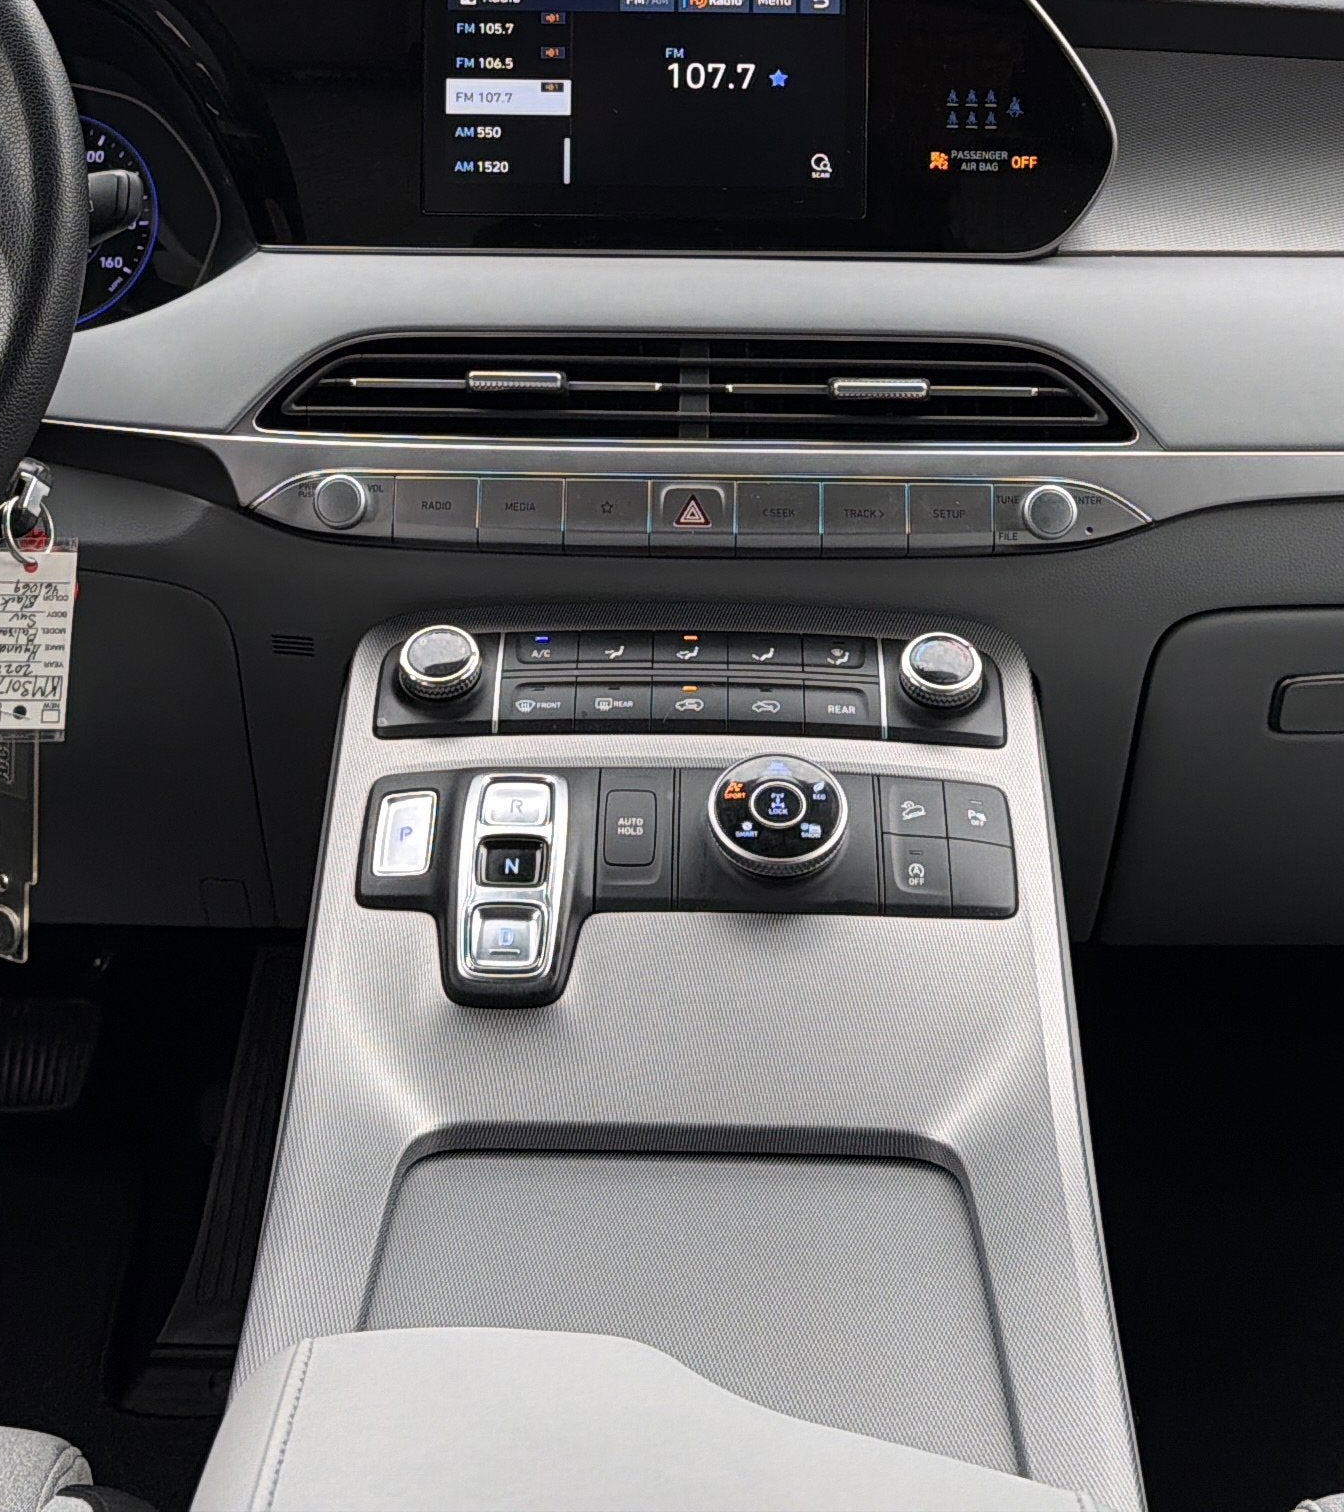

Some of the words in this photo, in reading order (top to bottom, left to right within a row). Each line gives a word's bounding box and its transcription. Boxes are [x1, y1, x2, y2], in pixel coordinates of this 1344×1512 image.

[456, 22, 475, 35] FM
[478, 22, 514, 35] 105.7
[665, 48, 684, 59] FM
[456, 57, 475, 69] FM
[478, 57, 514, 70] 106.5
[666, 63, 756, 90] 107.7
[455, 92, 474, 104] FM
[478, 92, 513, 104] 107.7
[454, 126, 474, 138] AM
[476, 126, 502, 139] 550
[951, 150, 1008, 160] PASSENGER
[1011, 156, 1038, 169] OFF
[454, 161, 474, 173] AM
[476, 161, 509, 174] 1520
[960, 162, 977, 171] AIR
[978, 162, 999, 172] BAG
[99, 256, 123, 268] 160
[421, 500, 452, 511] RADIO
[996, 496, 1020, 505] TUNE
[504, 502, 536, 513] MEDIA
[932, 508, 967, 519] SETUP
[999, 532, 1018, 541] FILE
[531, 648, 551, 658] A/C
[42, 701, 61, 709] NEW
[537, 701, 562, 709] FRONT
[610, 700, 634, 709] REAR
[827, 704, 856, 715] REAR
[509, 798, 524, 815] R
[618, 815, 644, 825] AUTO
[399, 825, 413, 843] P
[617, 826, 644, 836] HOLD
[503, 858, 520, 876] N
[908, 877, 925, 885] OFF
[499, 927, 515, 946] D
